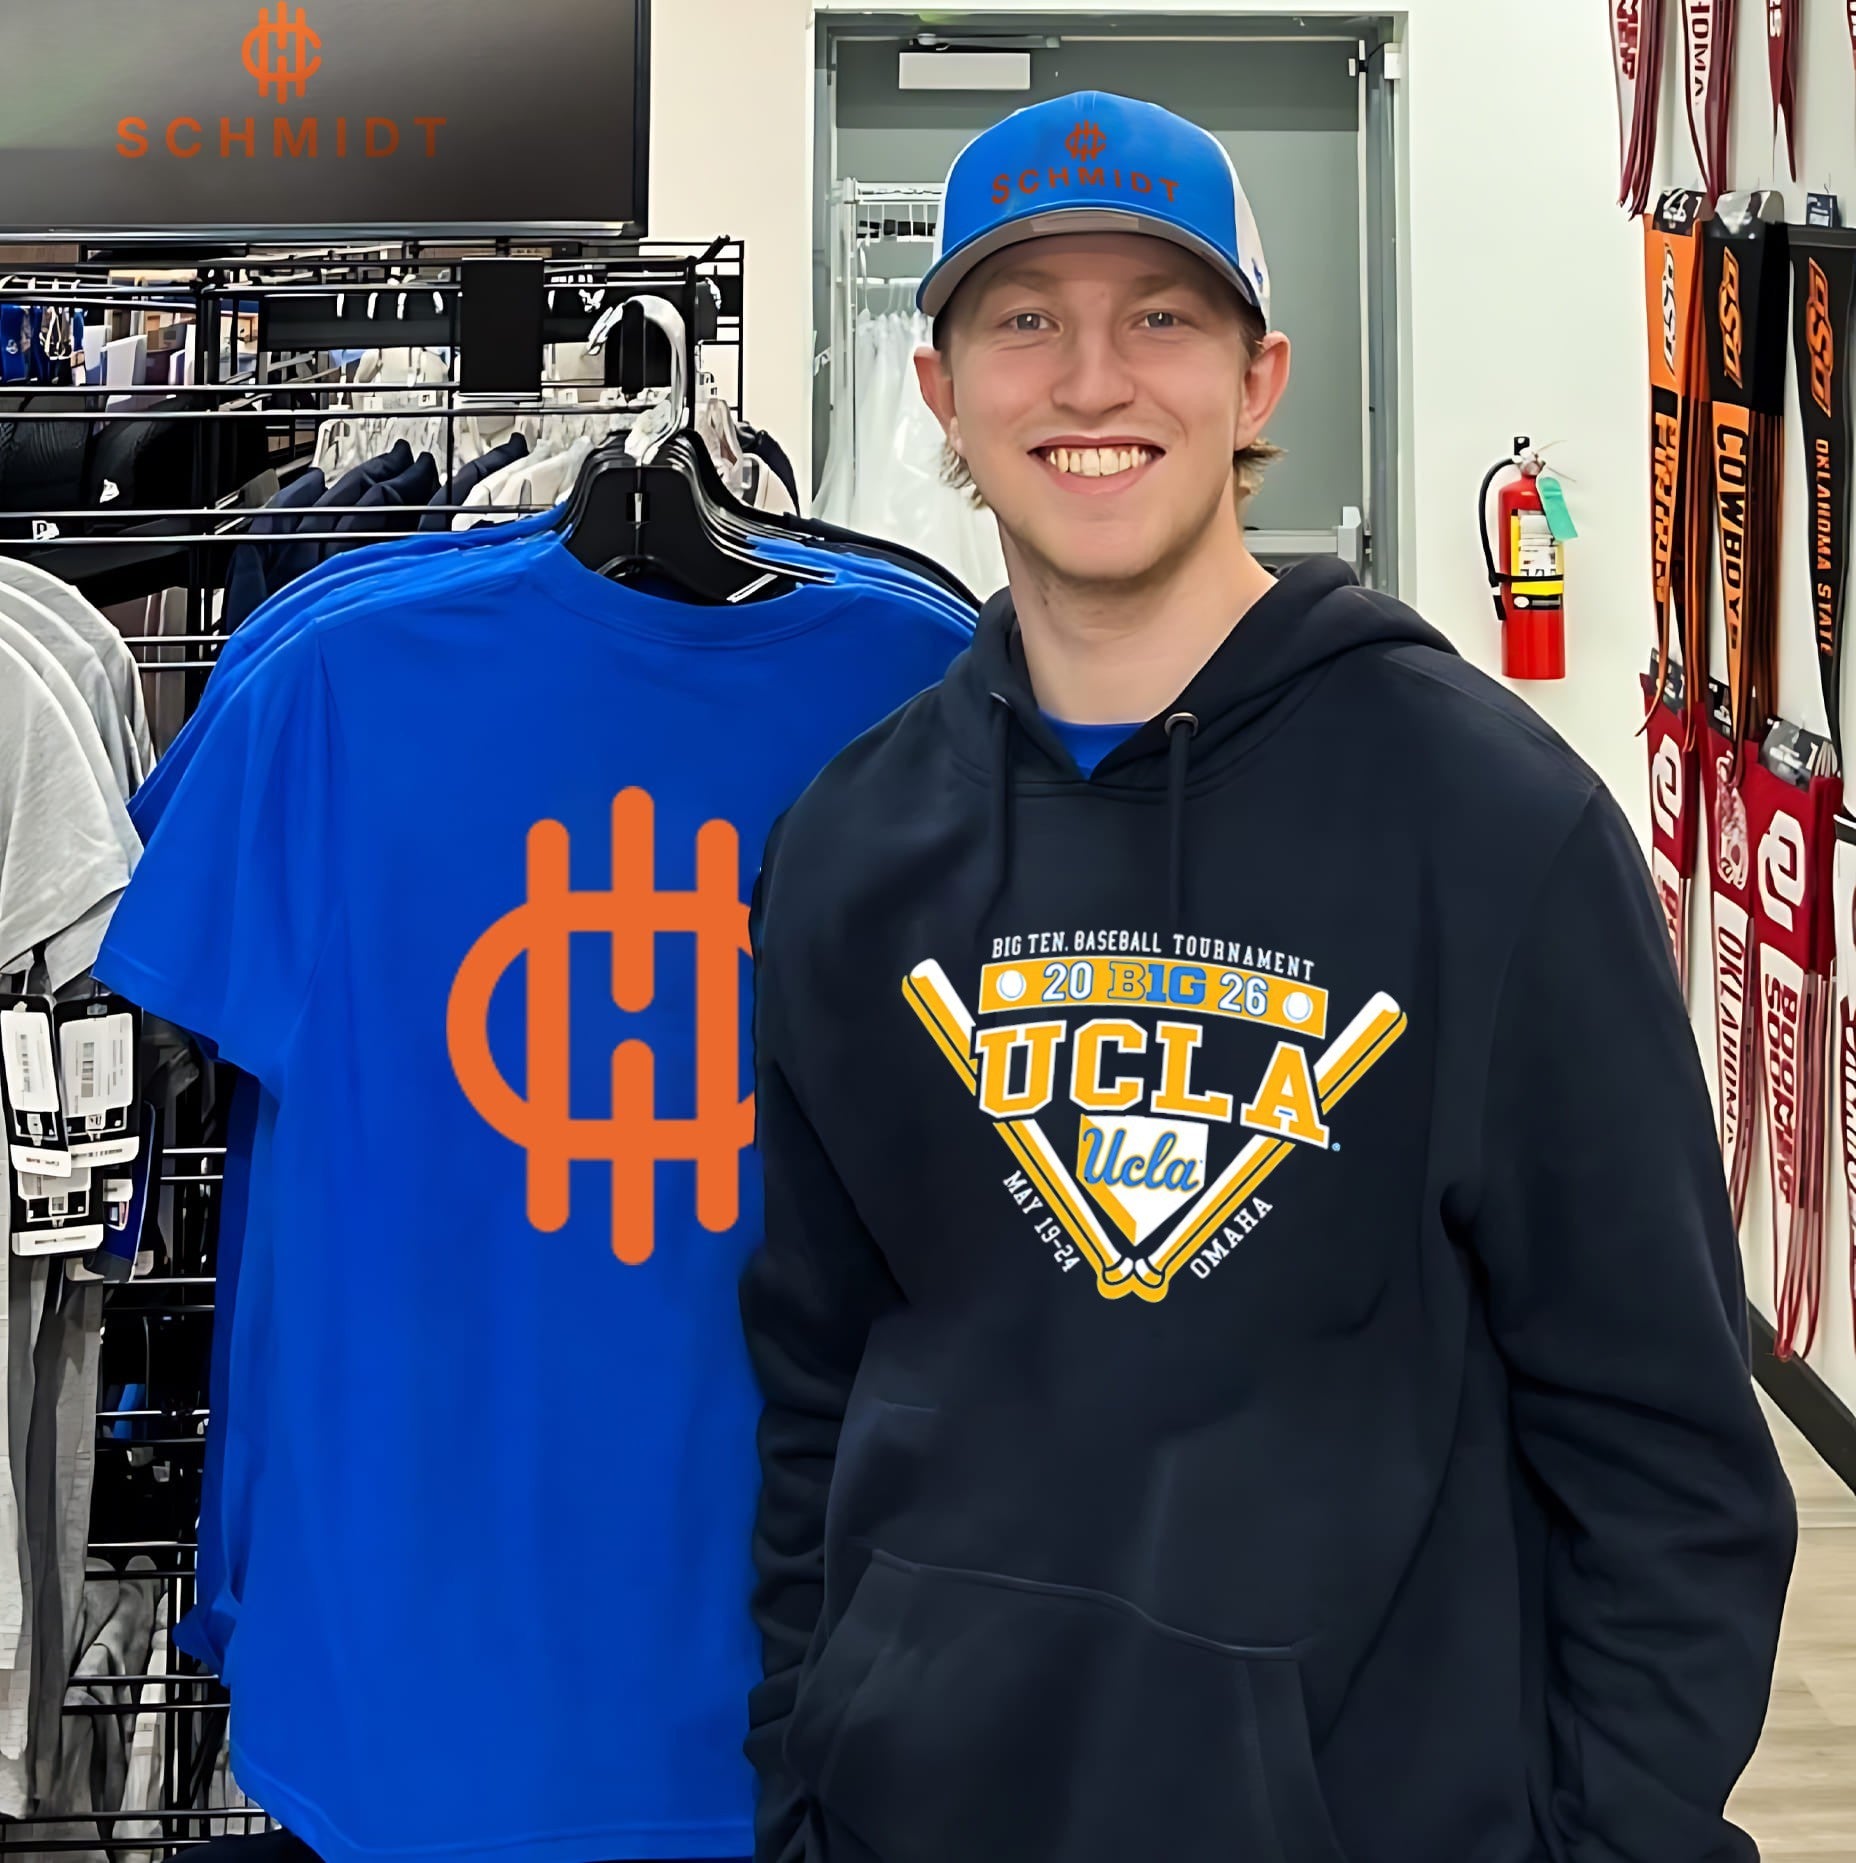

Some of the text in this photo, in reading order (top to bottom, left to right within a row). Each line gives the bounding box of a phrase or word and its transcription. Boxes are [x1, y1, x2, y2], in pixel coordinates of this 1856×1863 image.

[115, 117, 448, 158] SCHMIDT
[991, 166, 1179, 205] SCHMIDT
[1815, 438, 1834, 657] OKLAHOMA STATE
[991, 936, 1022, 958] BIG
[1074, 930, 1162, 953] BASEBALL
[1173, 934, 1315, 981] TOURNAMENT
[1041, 960, 1094, 1002] 20
[1218, 971, 1269, 1016] 26
[974, 1017, 1331, 1150] UCLA
[1082, 1126, 1200, 1191] Ucla
[1002, 1169, 1081, 1272] MAY 19-24
[1189, 1196, 1273, 1279] OMAHA
